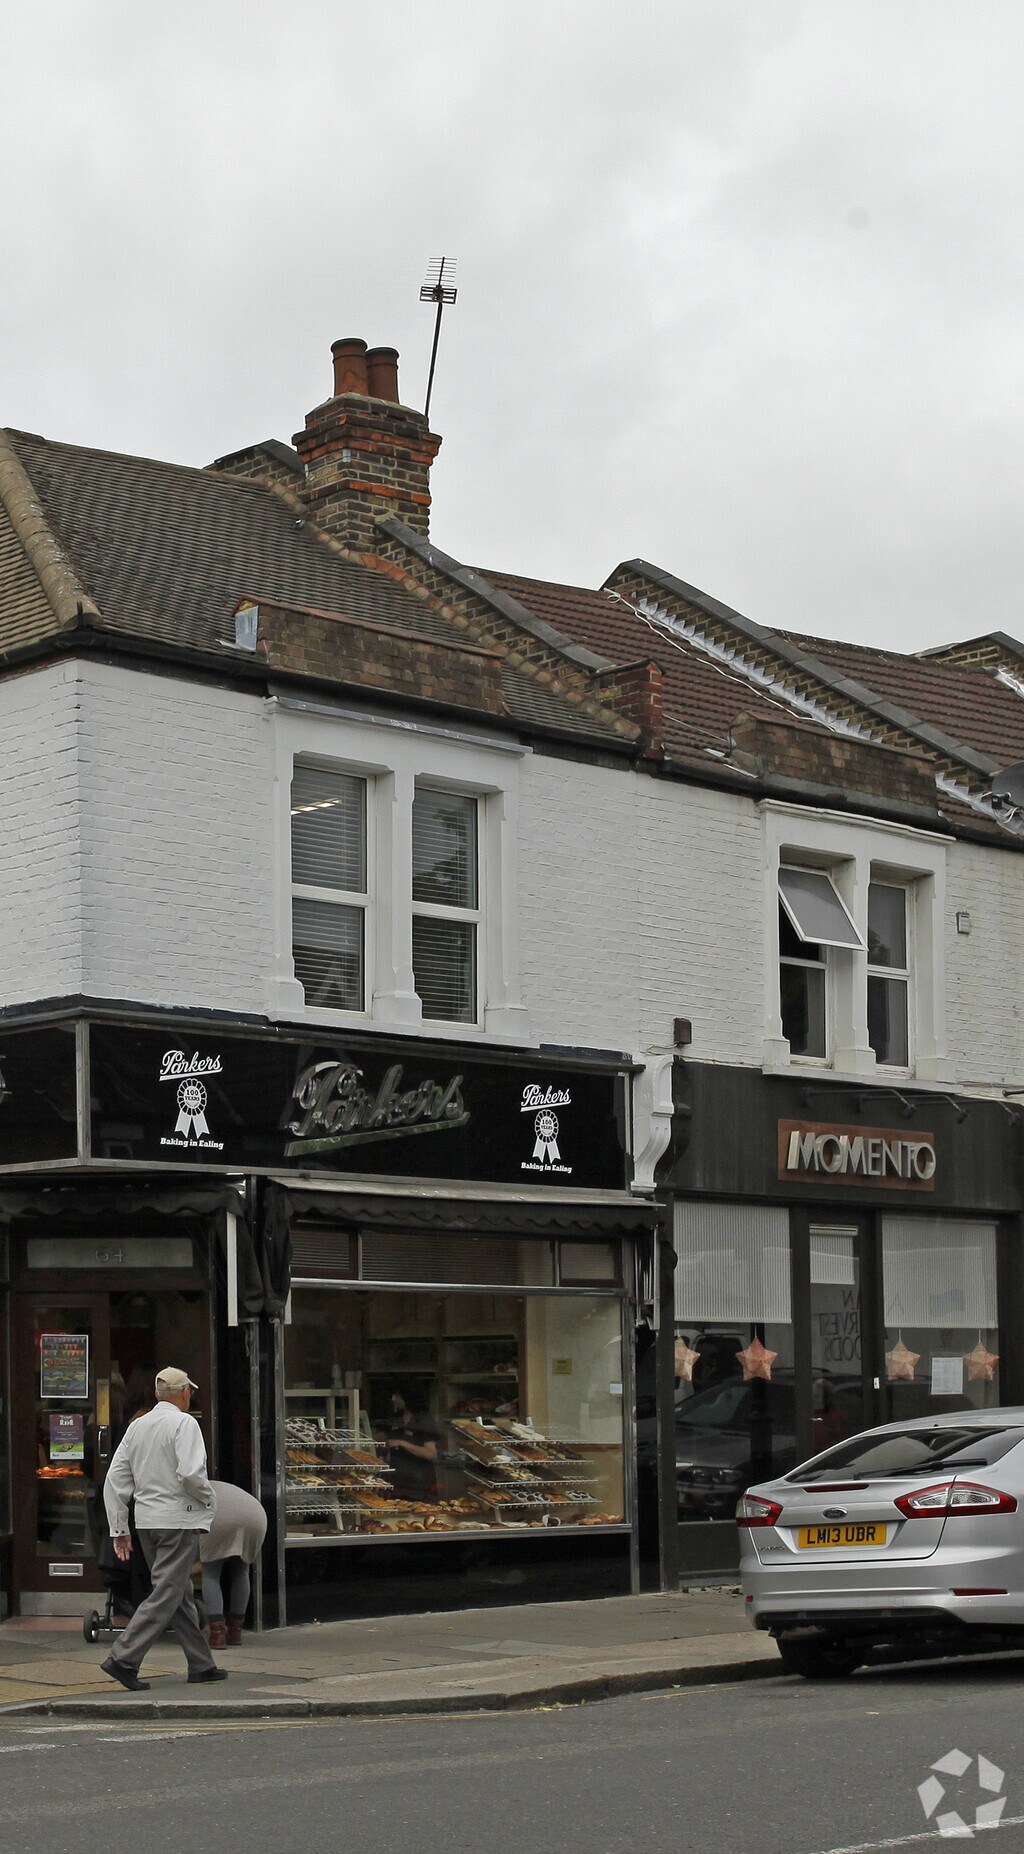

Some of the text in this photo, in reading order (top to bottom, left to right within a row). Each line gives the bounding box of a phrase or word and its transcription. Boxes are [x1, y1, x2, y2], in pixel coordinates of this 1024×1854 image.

[159, 1049, 223, 1075] Parkers
[285, 1060, 471, 1136] Parkers
[520, 1083, 572, 1106] Parkers
[160, 1137, 224, 1150] Baking in Ealing
[787, 1130, 936, 1180] MOMENTO
[521, 1163, 543, 1171] Baking
[552, 1165, 572, 1173] Ealing
[95, 1247, 124, 1263] 64
[807, 1526, 876, 1545] LM13 UBR
